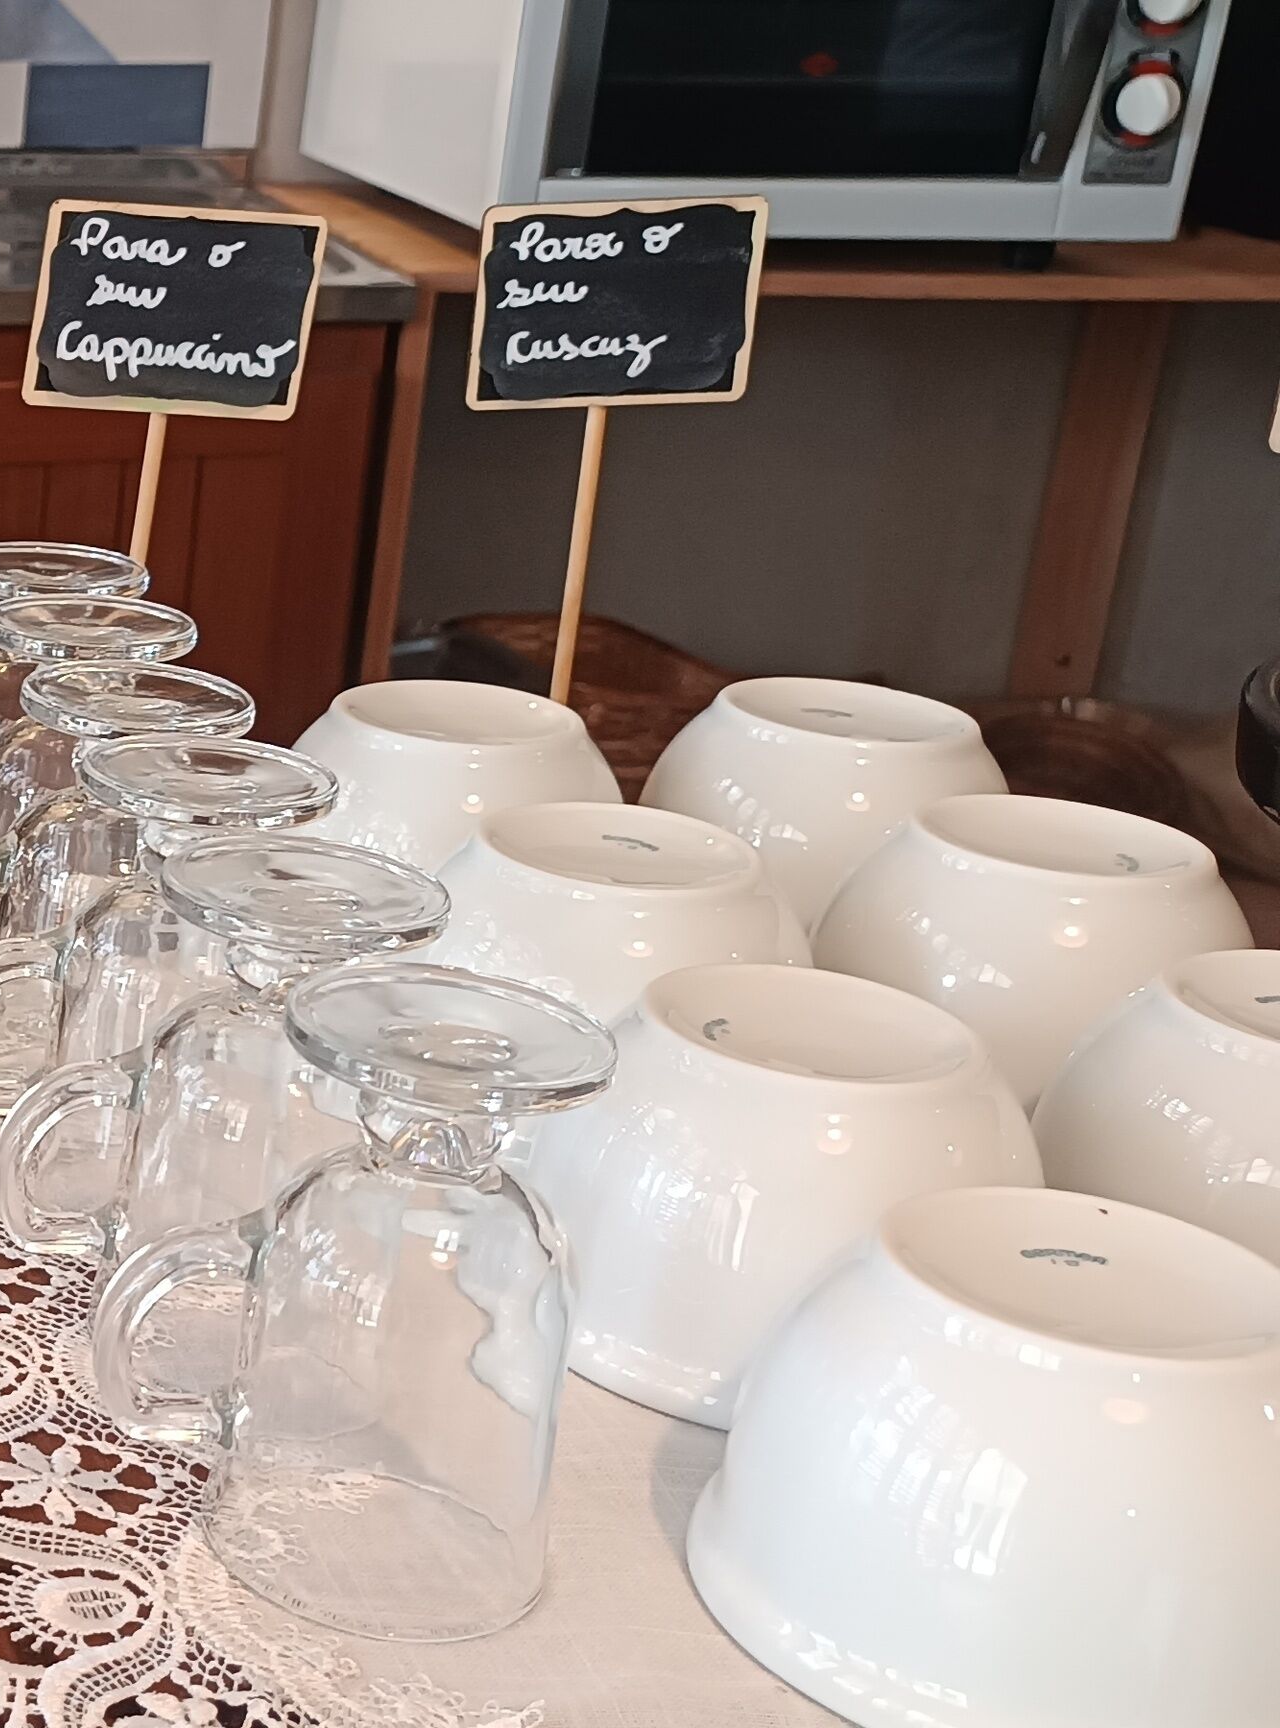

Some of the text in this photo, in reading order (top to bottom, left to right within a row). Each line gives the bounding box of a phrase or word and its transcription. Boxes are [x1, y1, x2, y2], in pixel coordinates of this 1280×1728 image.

[71, 217, 247, 268] Para o
[510, 221, 685, 263] Para o
[86, 274, 168, 309] seu
[496, 278, 589, 309] seu
[56, 320, 297, 382] Cappuccino
[506, 330, 668, 378] Cuscuz
